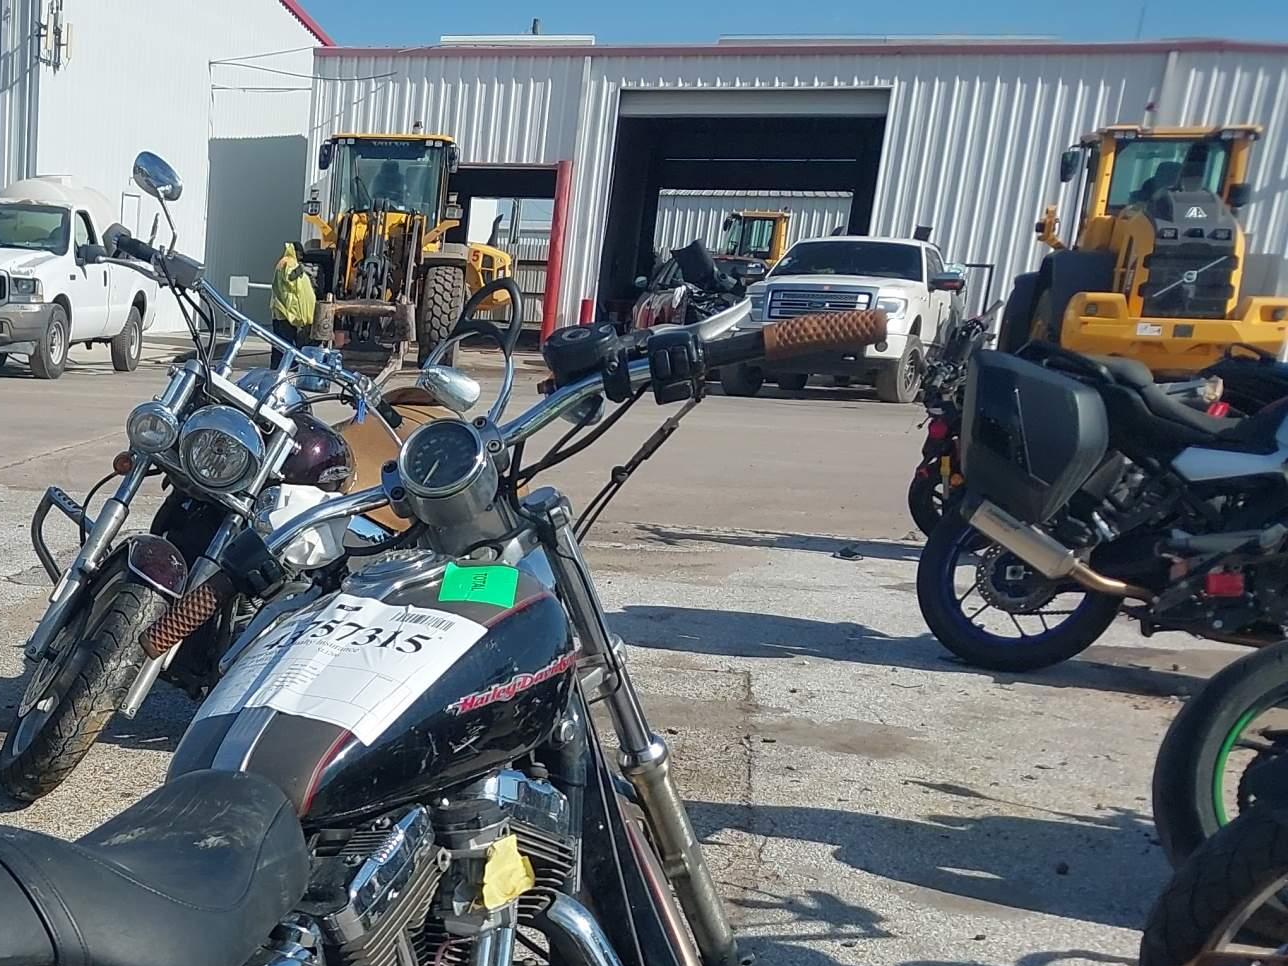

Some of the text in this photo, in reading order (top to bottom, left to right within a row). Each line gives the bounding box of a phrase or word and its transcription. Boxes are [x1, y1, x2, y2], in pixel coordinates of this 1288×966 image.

[471, 249, 481, 262] 5
[471, 572, 488, 592] TOTAL
[457, 652, 576, 713] Harley-Davids
